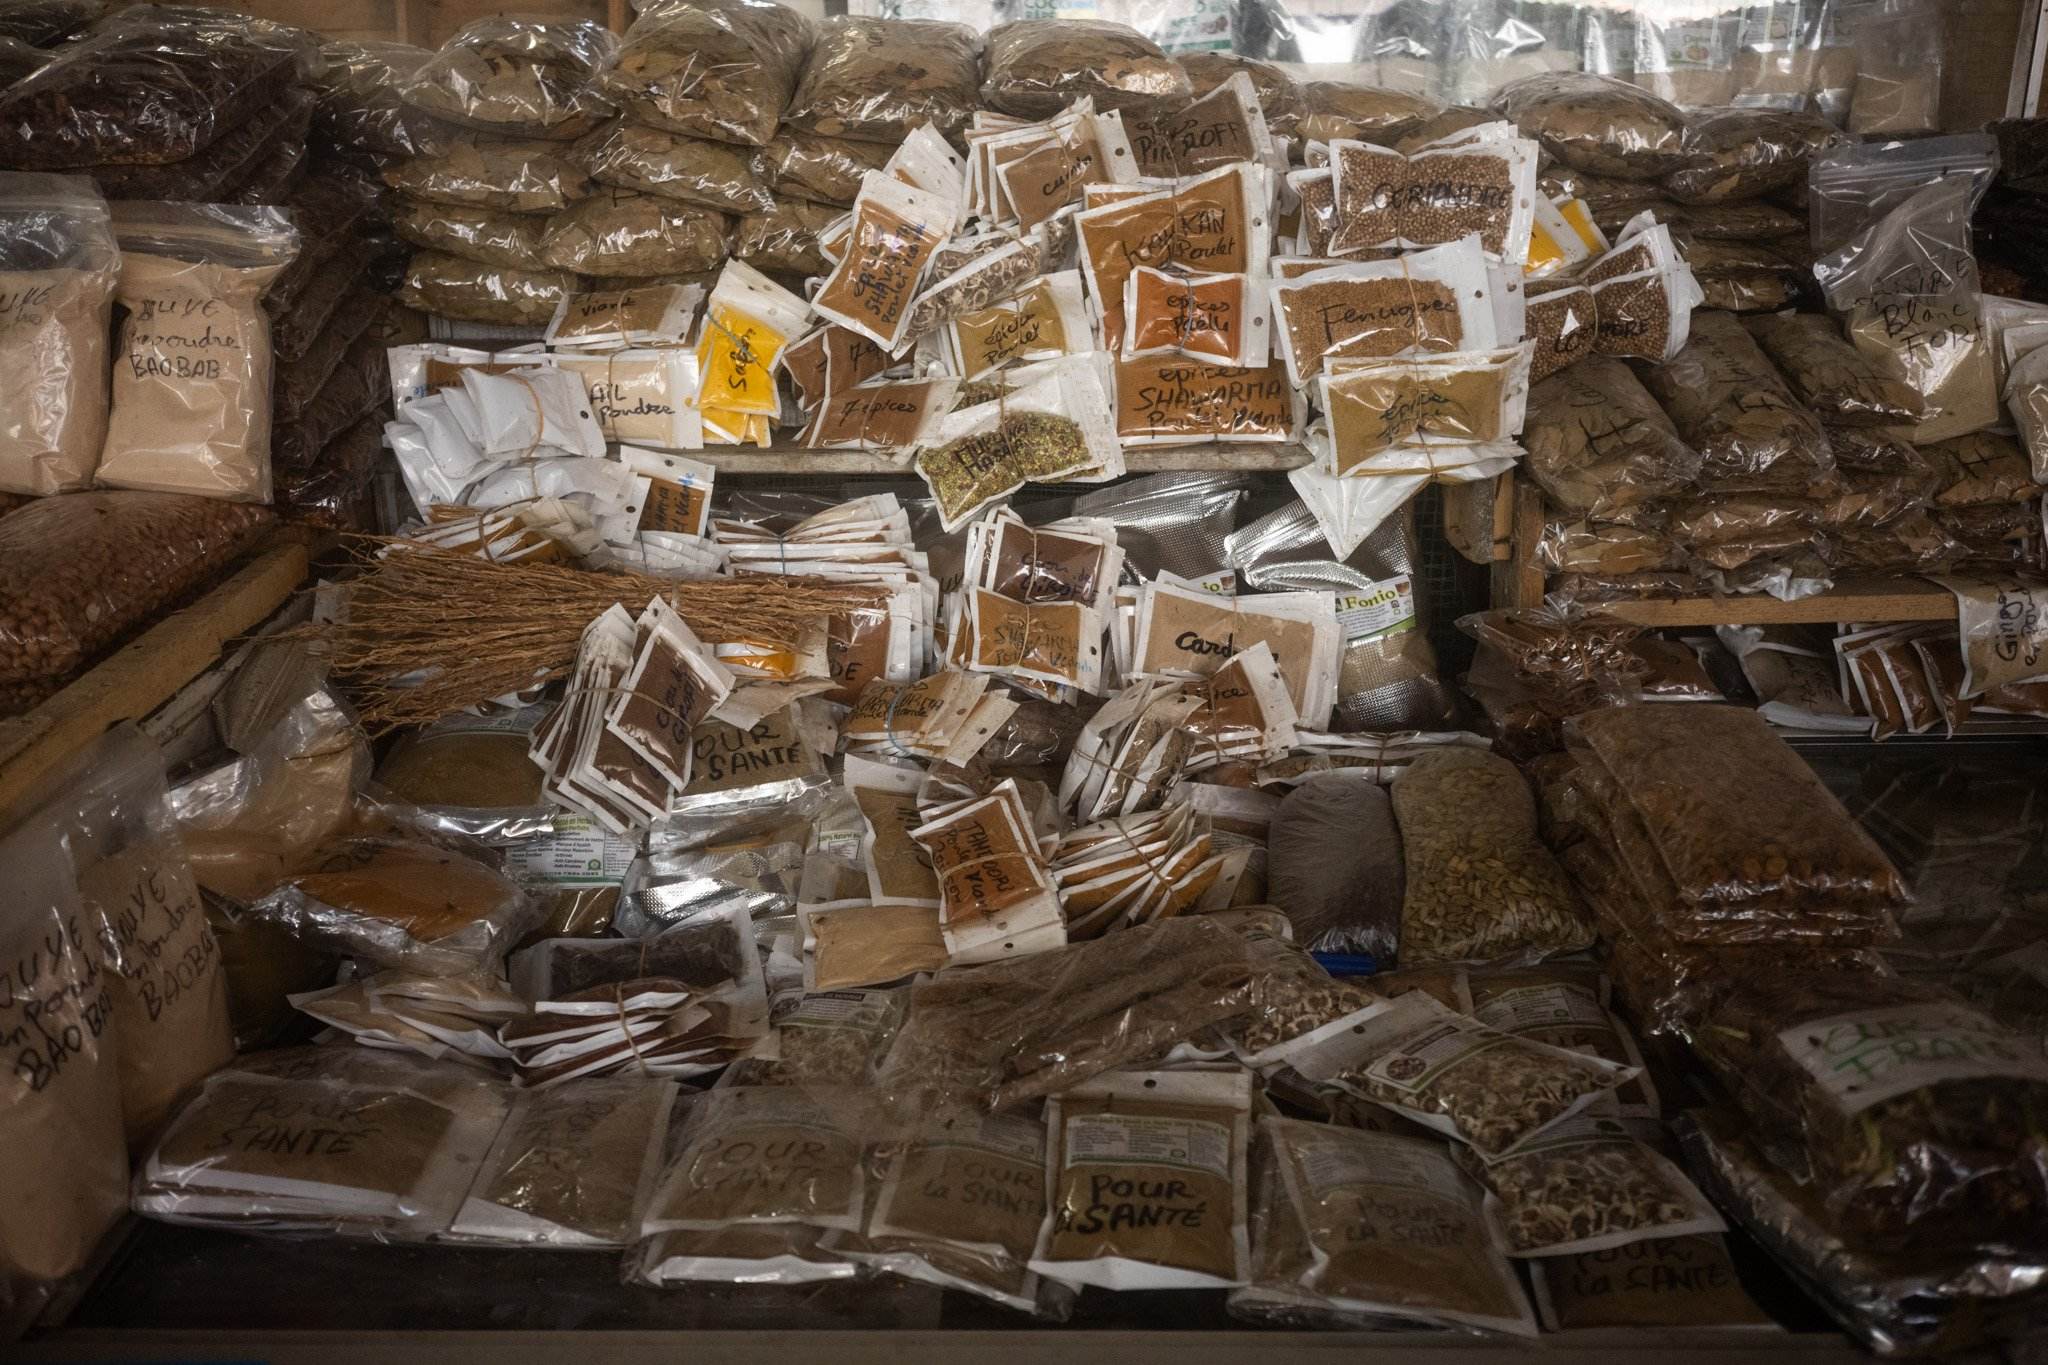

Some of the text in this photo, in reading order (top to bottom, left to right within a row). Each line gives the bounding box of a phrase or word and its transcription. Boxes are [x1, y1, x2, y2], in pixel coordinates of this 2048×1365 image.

[1884, 300, 1970, 339] Blanc
[130, 354, 219, 378] BAOBAB
[1345, 588, 1395, 610] Fonio
[693, 724, 780, 760] OUR
[1090, 1174, 1197, 1206] POUR
